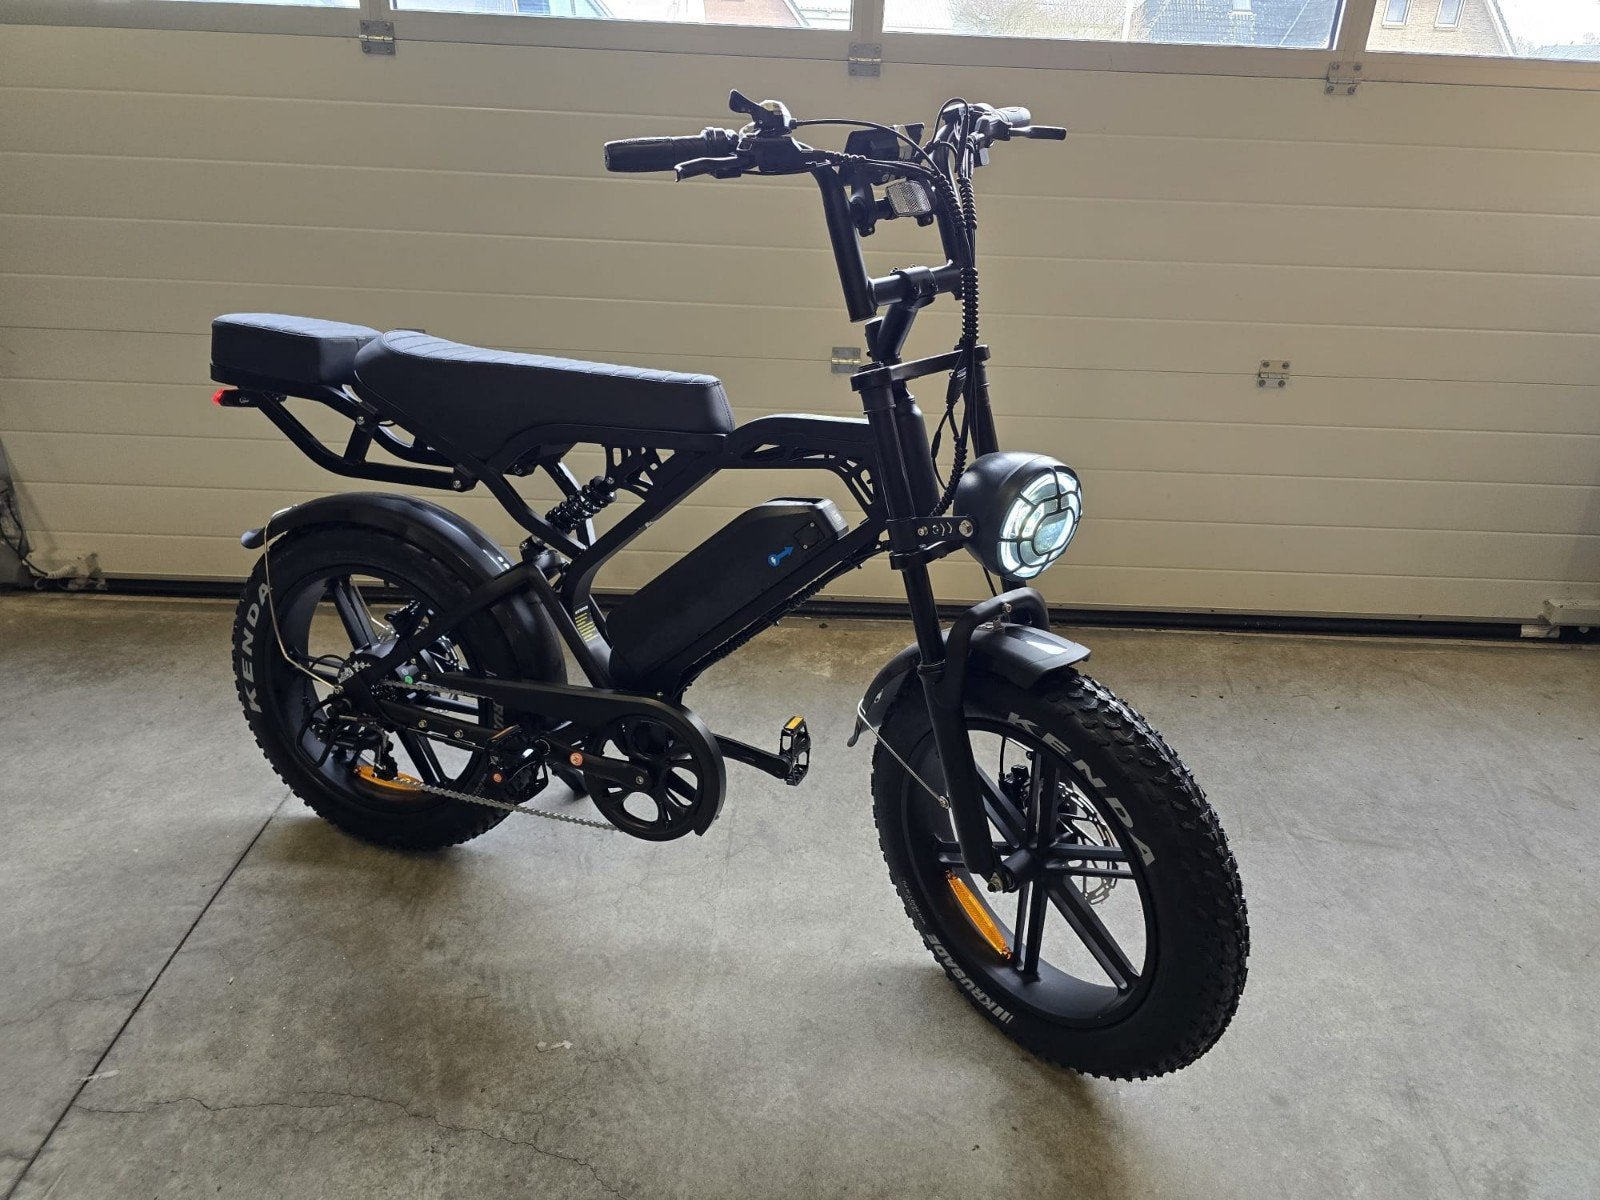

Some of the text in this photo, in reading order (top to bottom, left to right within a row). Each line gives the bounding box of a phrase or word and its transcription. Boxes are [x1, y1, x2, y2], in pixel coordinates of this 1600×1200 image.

[241, 582, 270, 713] KENDA
[1007, 711, 1155, 866] KENDA
[925, 933, 998, 1010] KRUSADE
